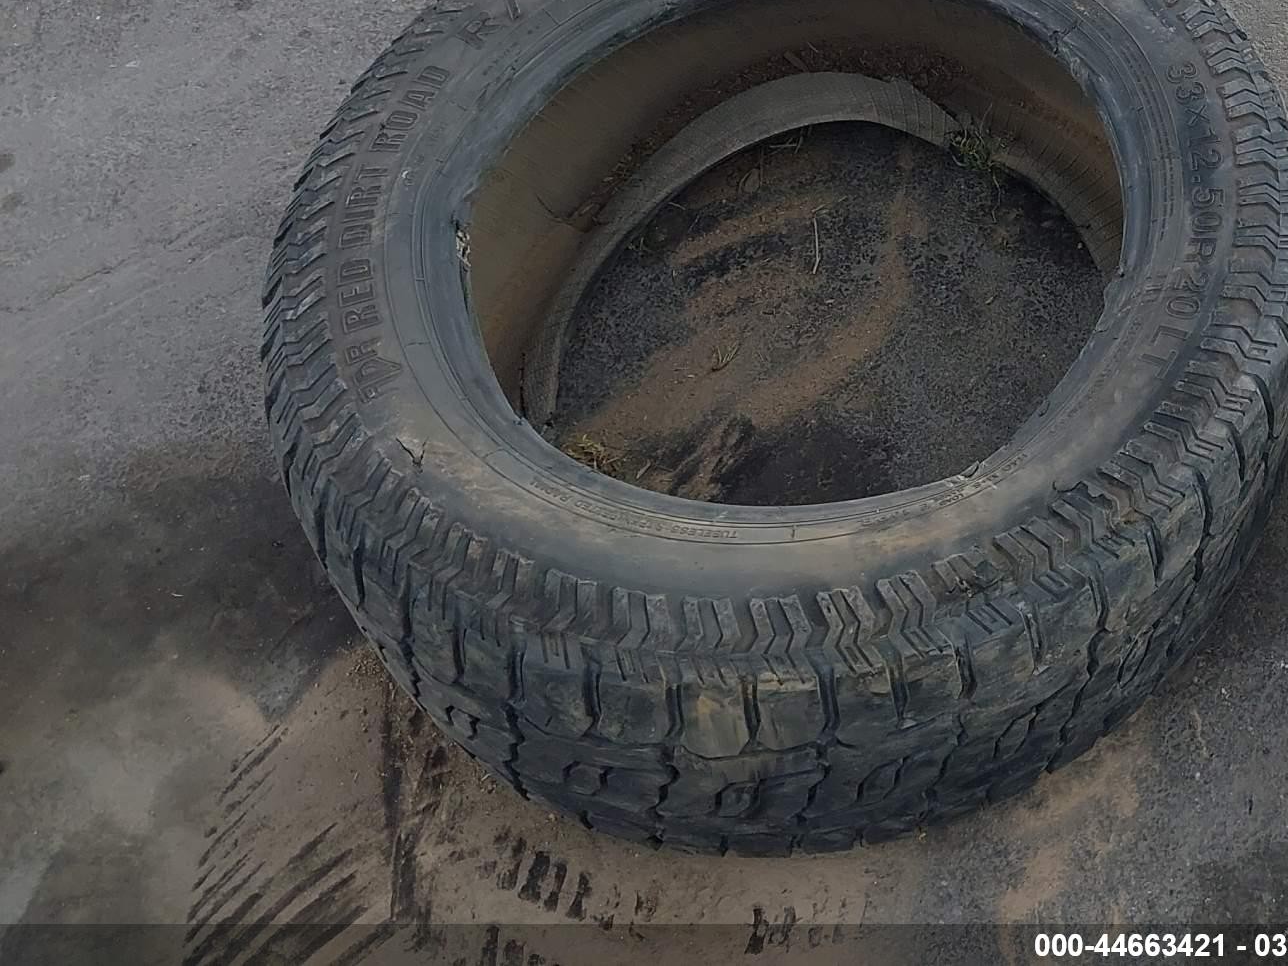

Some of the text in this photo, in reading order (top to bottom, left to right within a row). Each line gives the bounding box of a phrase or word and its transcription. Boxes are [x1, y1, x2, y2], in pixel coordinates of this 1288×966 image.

[368, 64, 452, 153] ROAD
[338, 162, 390, 250] DIRT
[337, 258, 383, 333] RED
